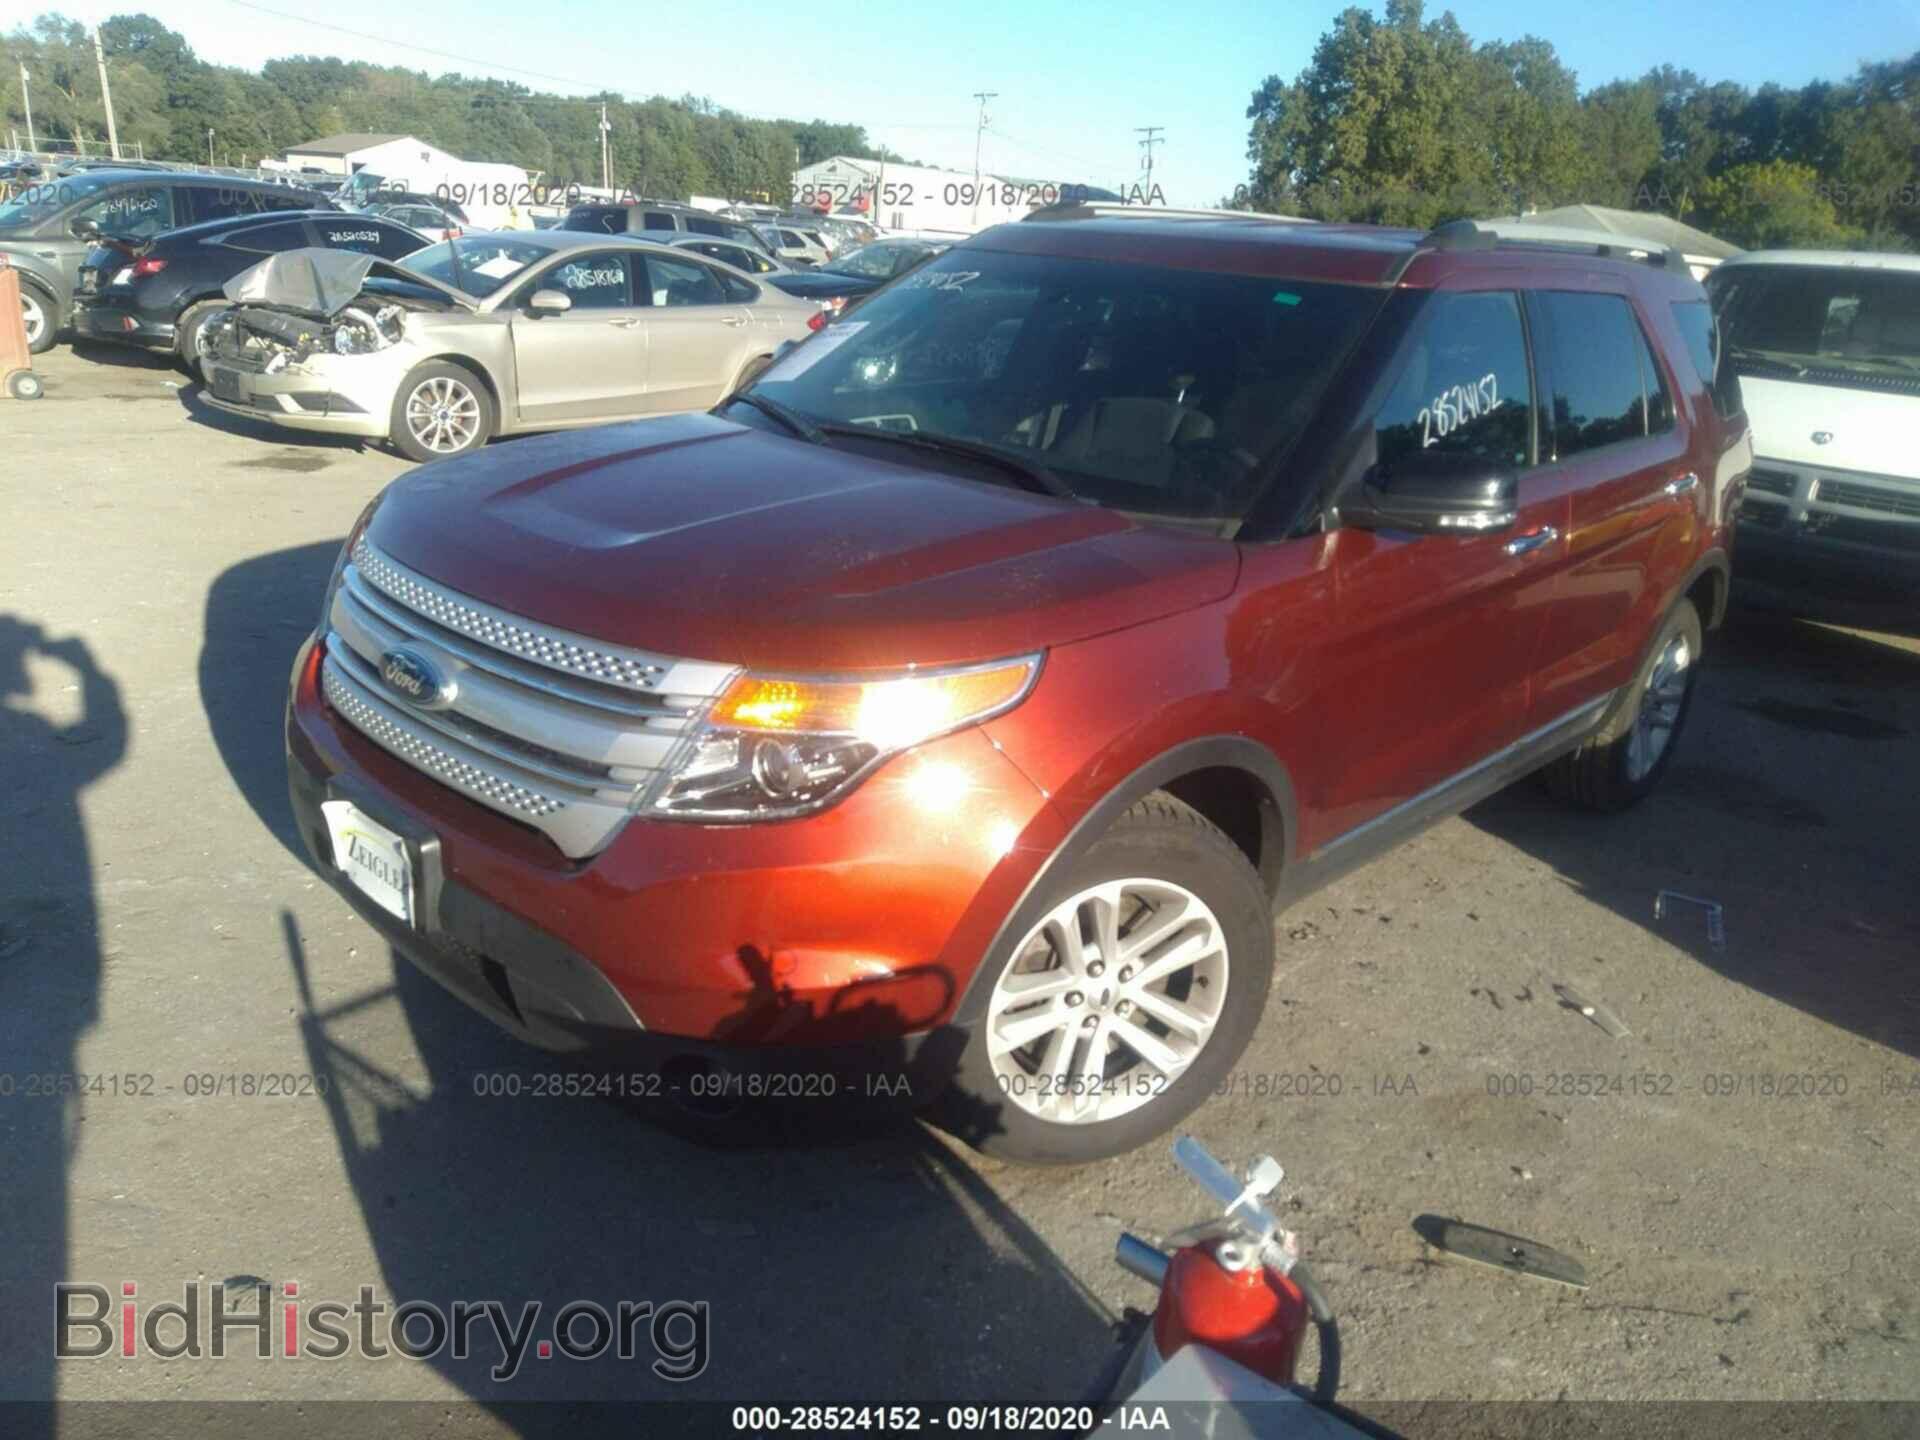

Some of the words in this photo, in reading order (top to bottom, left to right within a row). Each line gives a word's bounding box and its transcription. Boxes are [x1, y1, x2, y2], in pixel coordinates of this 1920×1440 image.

[1416, 372, 1504, 448] 28524152
[384, 653, 426, 695] Ford
[347, 832, 406, 892] ZEIGLE
